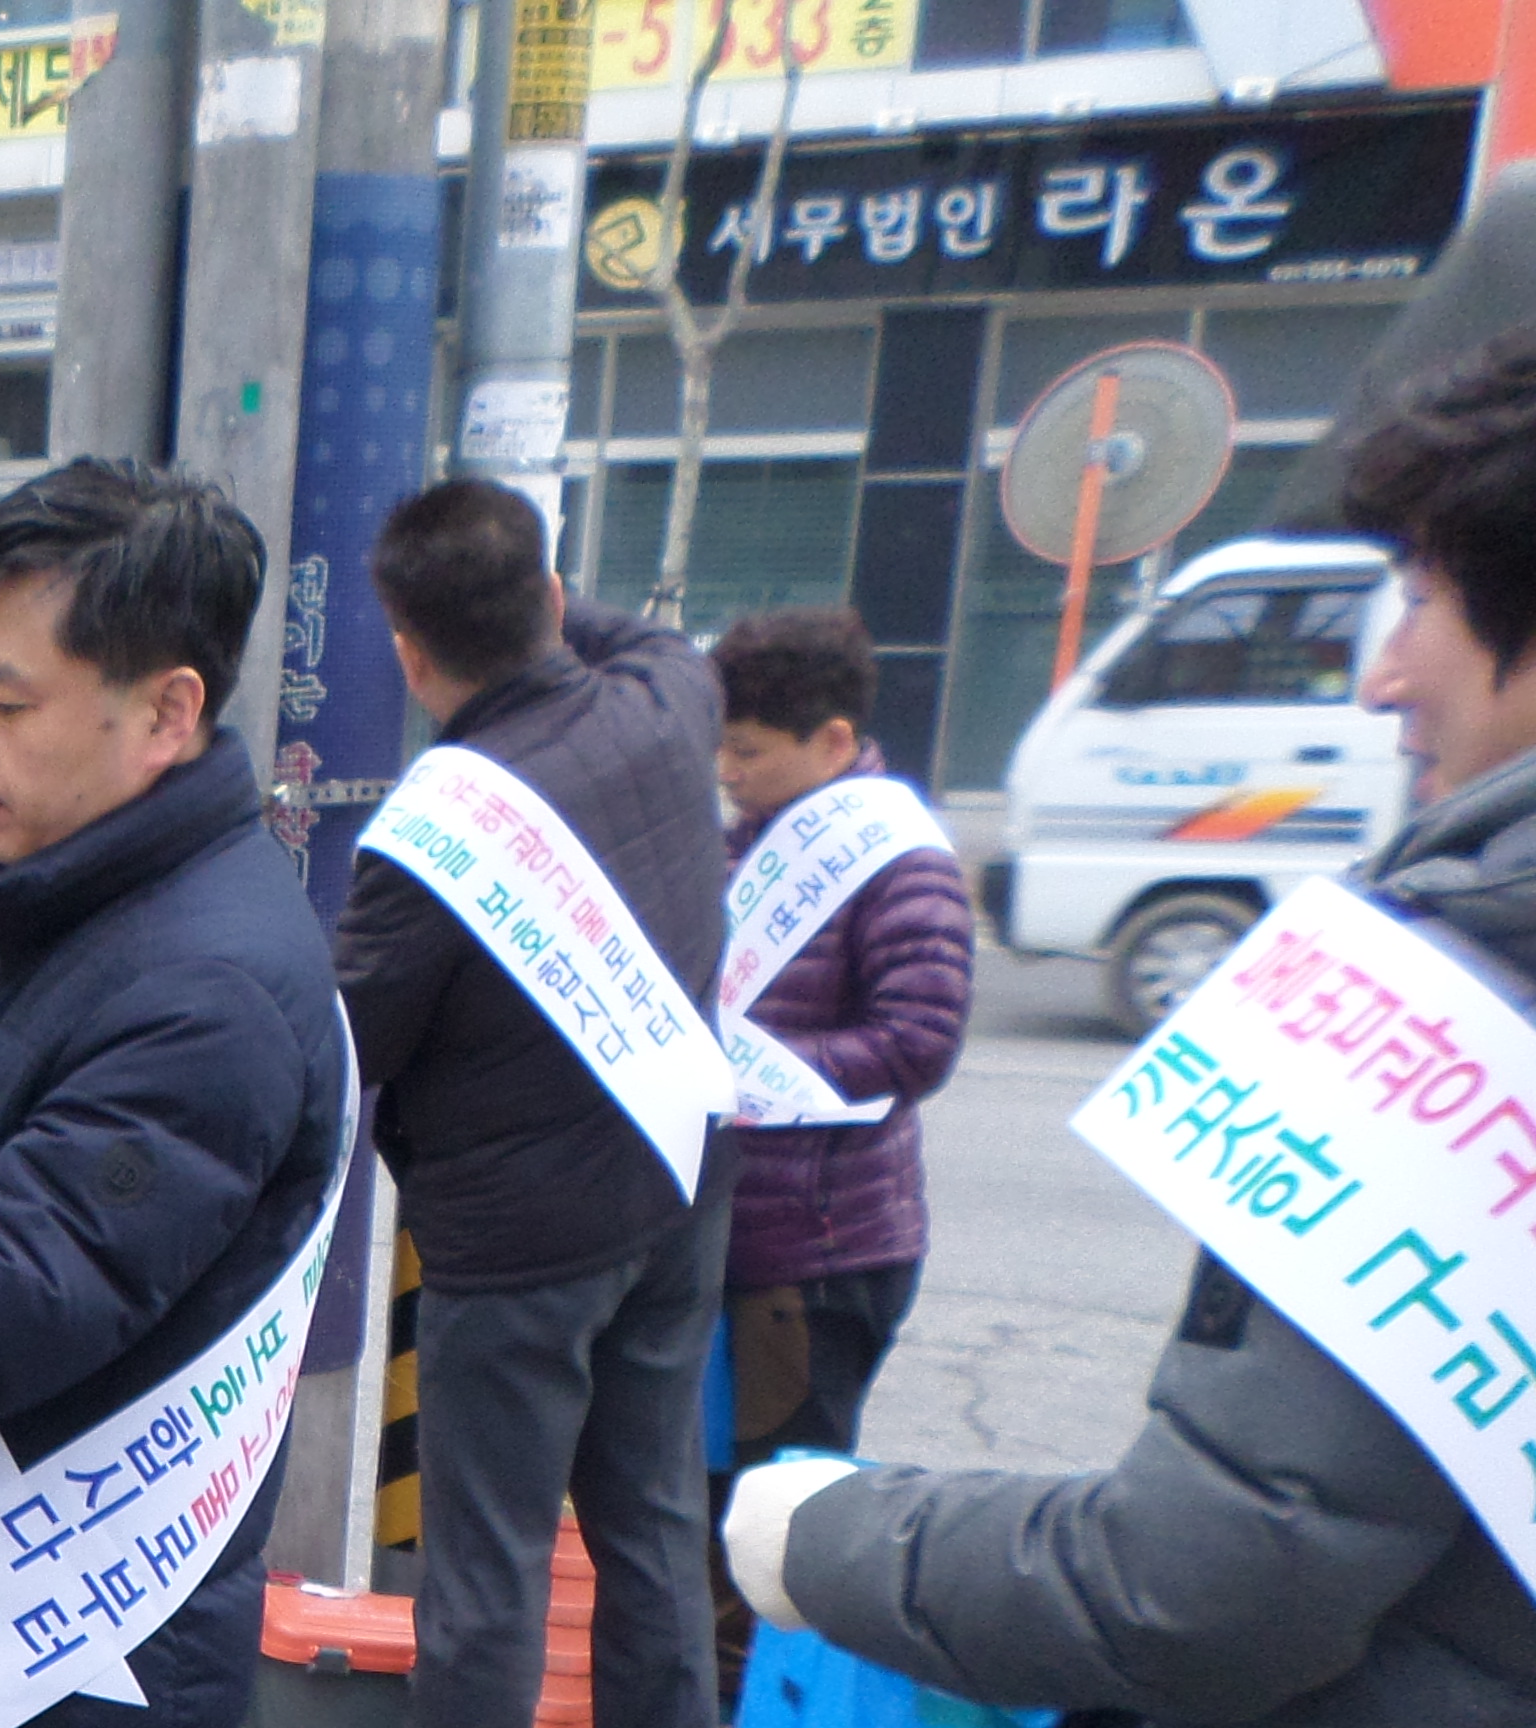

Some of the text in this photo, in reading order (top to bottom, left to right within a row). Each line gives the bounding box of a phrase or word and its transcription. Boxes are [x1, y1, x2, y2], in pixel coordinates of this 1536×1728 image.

[708, 183, 996, 263] 세무법인
[476, 880, 635, 1066] 보호합시다
[1109, 1031, 1364, 1238] 깨끗한
[0, 1310, 288, 1572] 보호합시다
